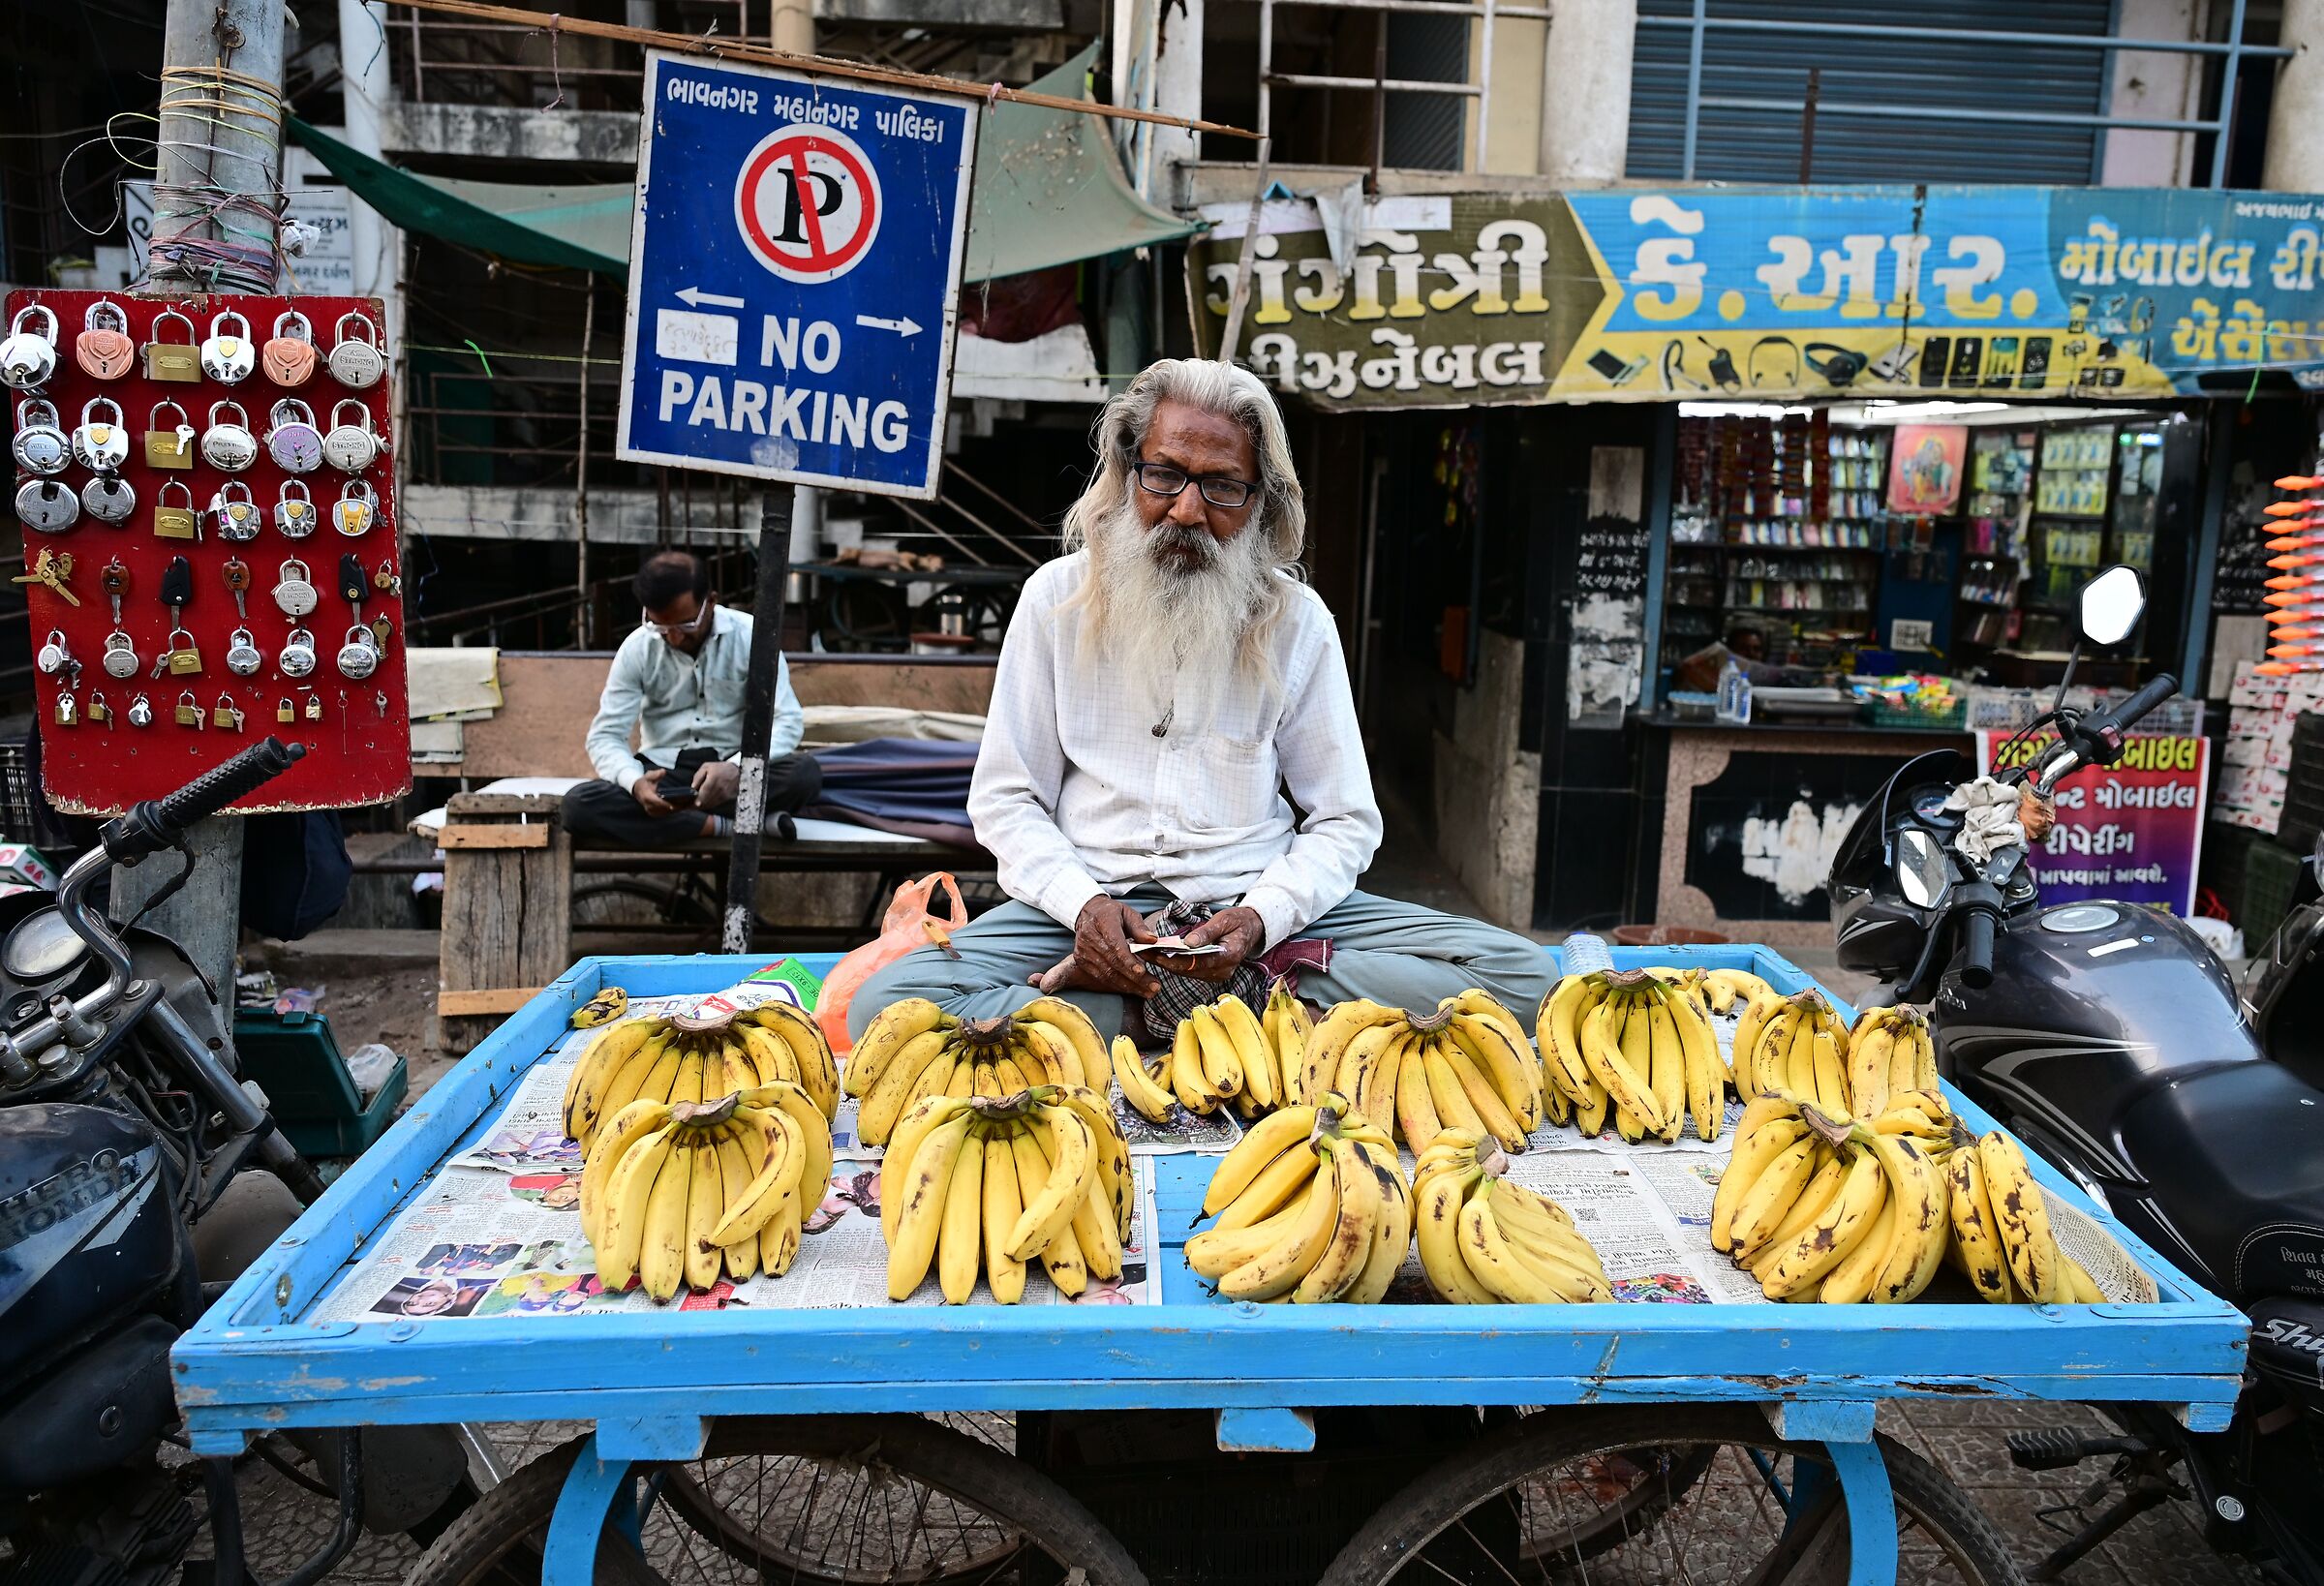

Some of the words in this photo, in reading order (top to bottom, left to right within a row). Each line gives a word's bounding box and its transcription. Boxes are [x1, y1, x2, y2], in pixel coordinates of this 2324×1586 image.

[666, 77, 758, 115] ભાવનગર
[773, 94, 860, 130] મહાનગર
[875, 104, 944, 143] પાલિકા
[1630, 196, 1746, 322] કે.
[1755, 234, 2038, 320] આર.
[2269, 221, 2324, 291] રી
[760, 314, 841, 375] NO
[658, 369, 909, 453] PARKING
[2252, 1319, 2324, 1355] Shi
